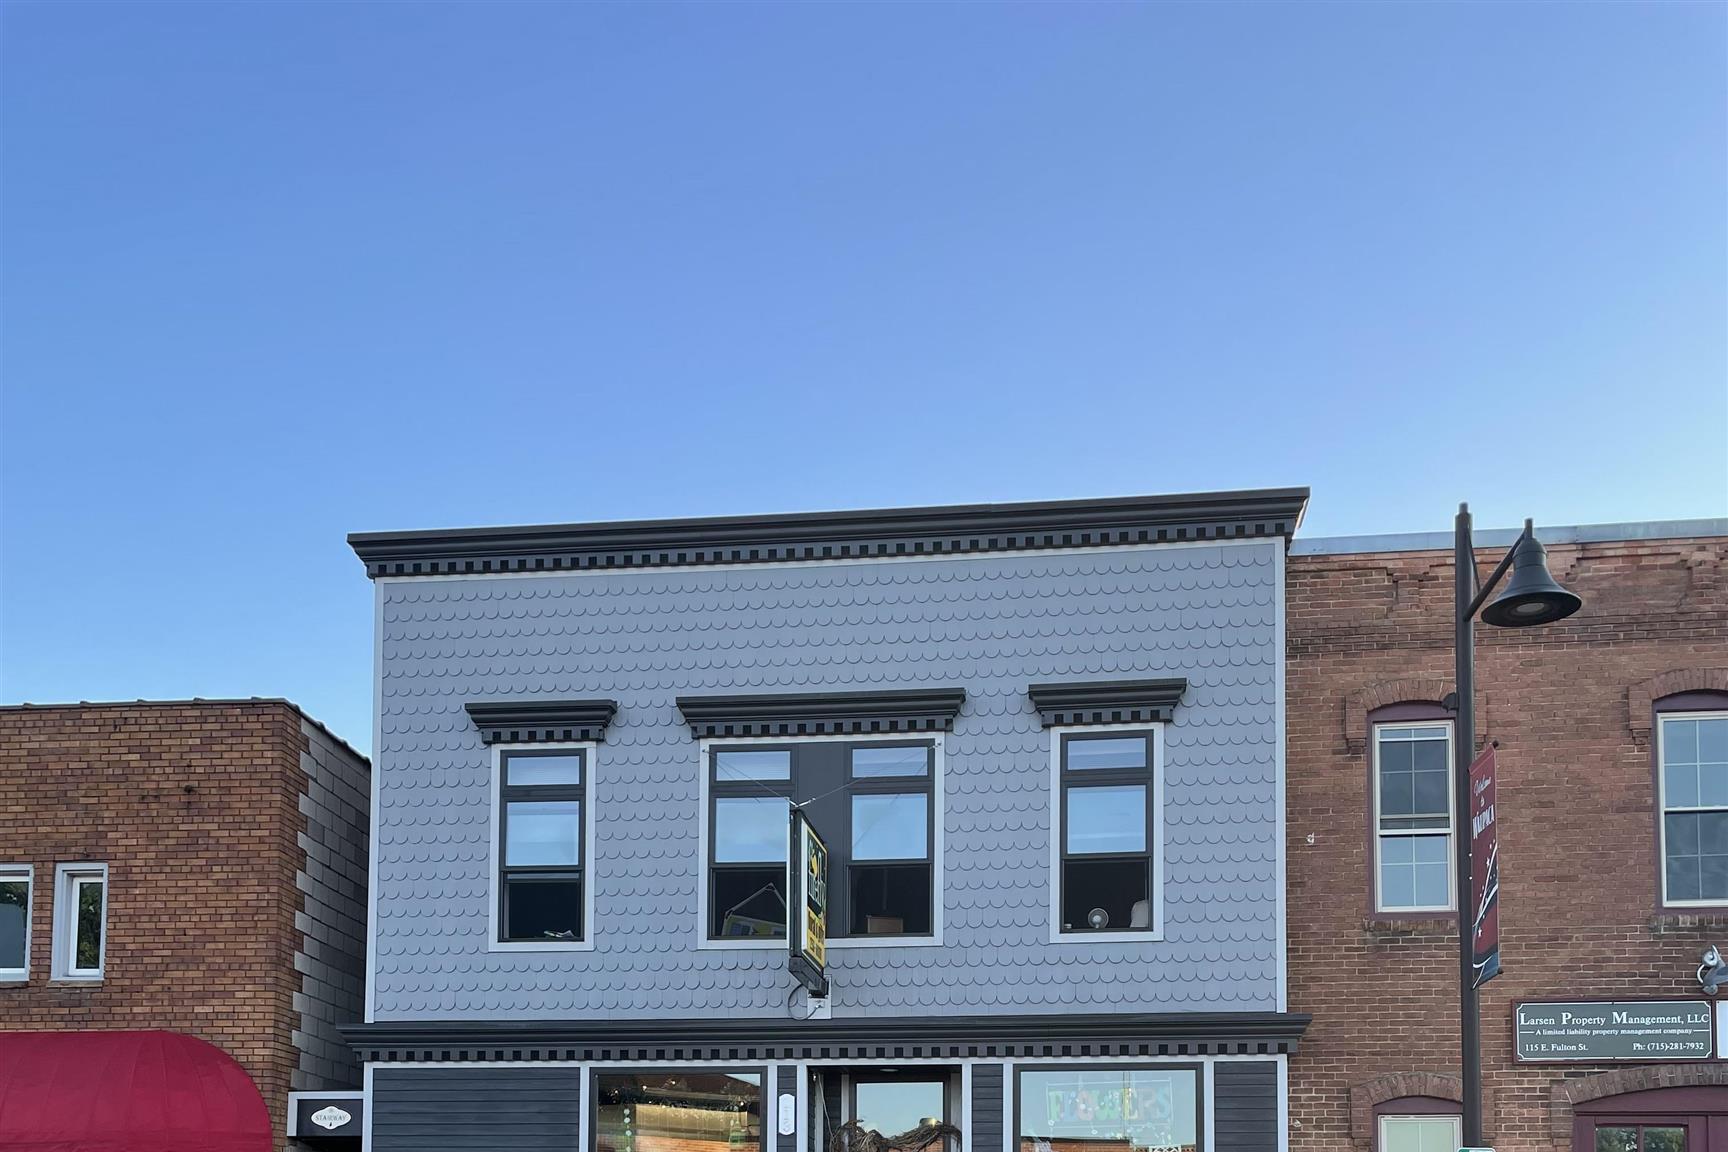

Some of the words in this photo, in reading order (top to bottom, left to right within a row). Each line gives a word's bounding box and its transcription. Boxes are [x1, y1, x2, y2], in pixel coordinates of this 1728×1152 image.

[1520, 1012, 1555, 1025] Larsen
[1561, 1012, 1606, 1026] Property
[1612, 1011, 1684, 1025] Management,
[1687, 1013, 1709, 1023] LLC
[1525, 1043, 1539, 1051] 115
[1551, 1043, 1576, 1051] Fulton
[1633, 1042, 1646, 1050] Ph:
[1647, 1042, 1704, 1051] (715)-281-7932
